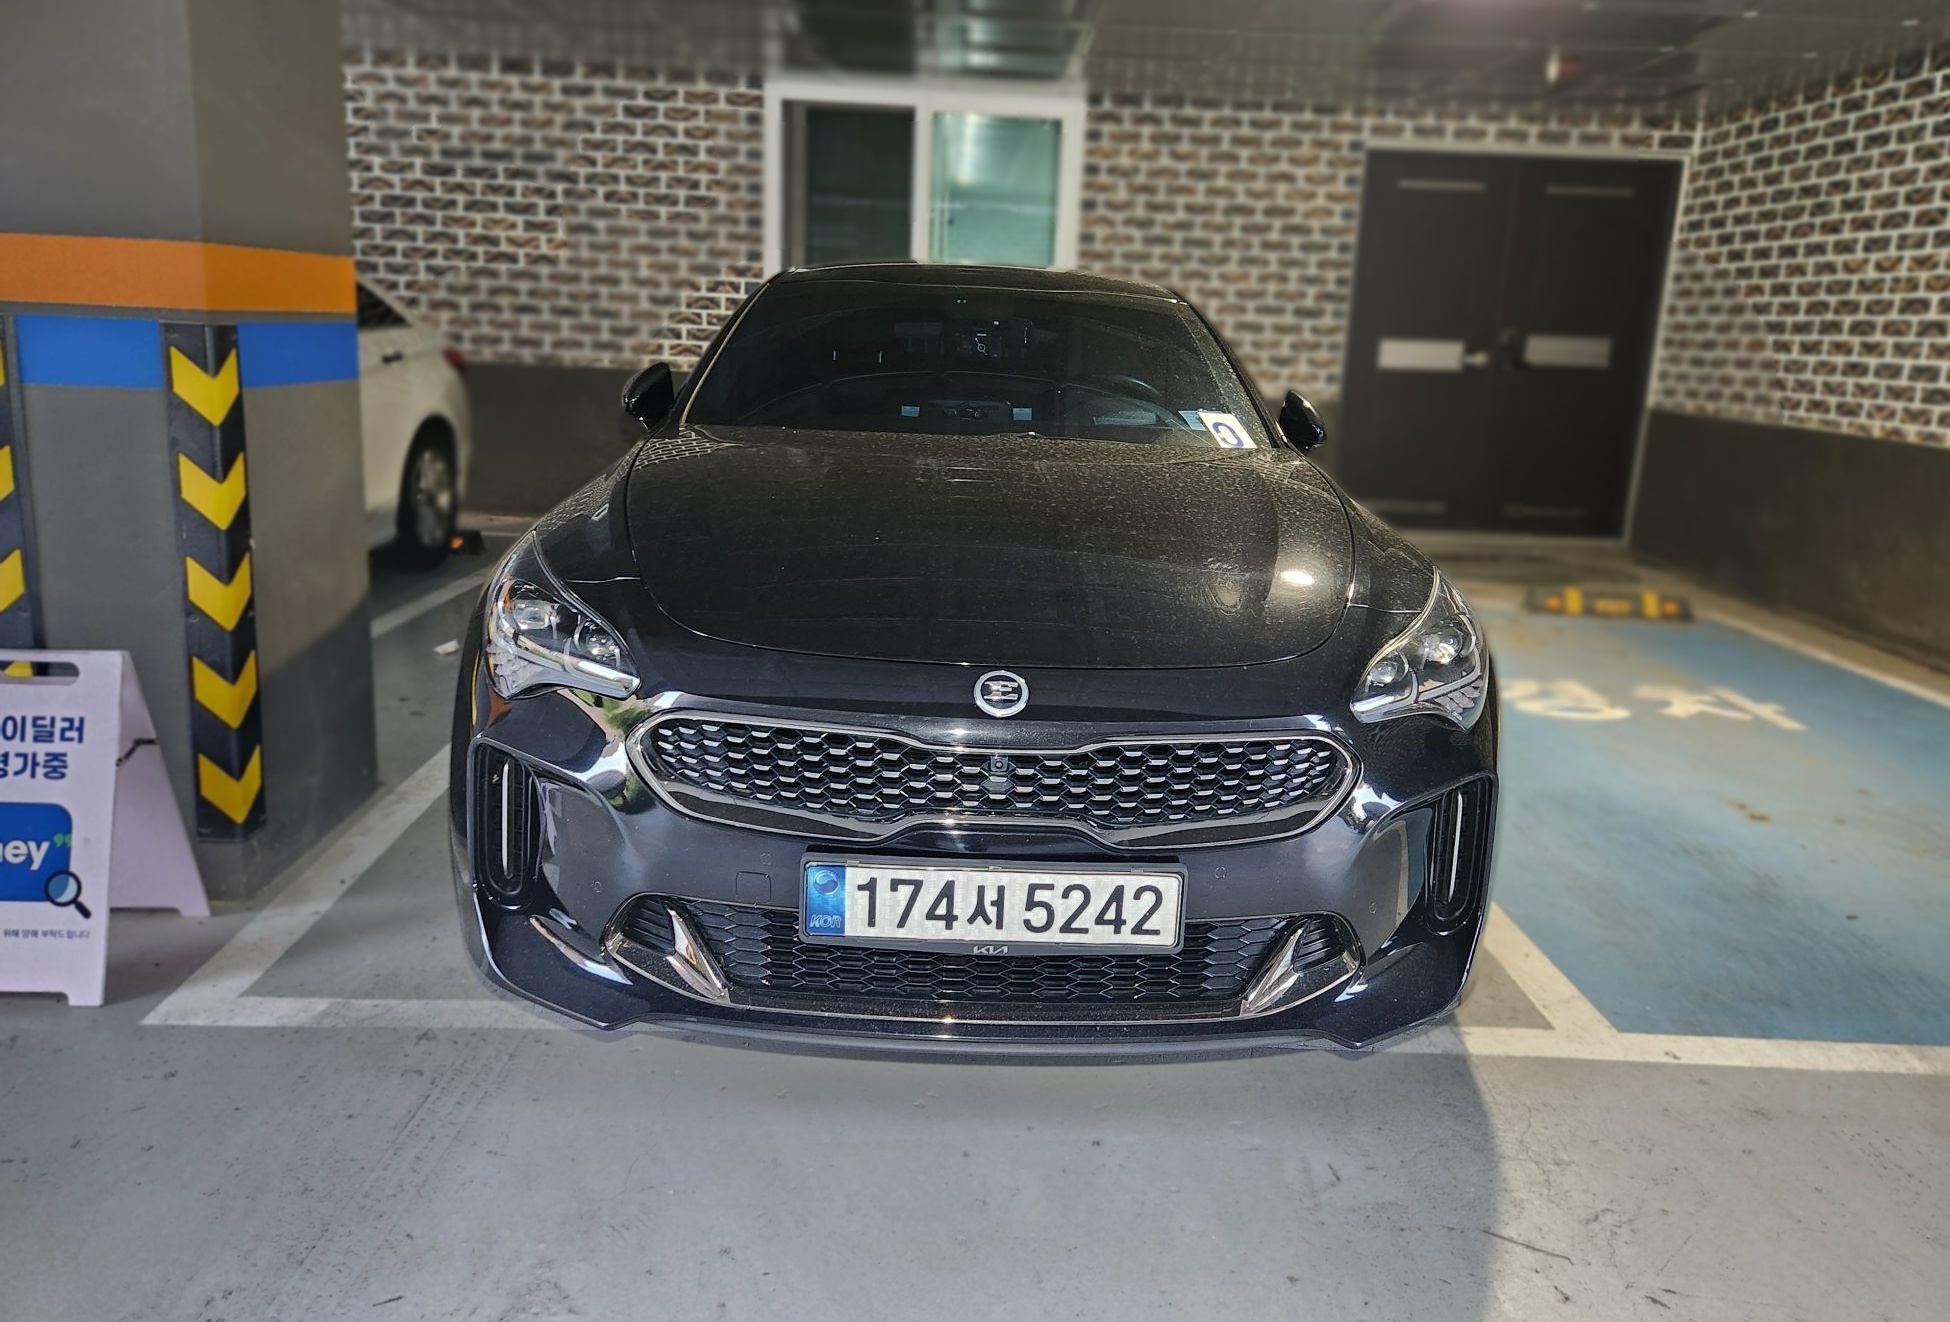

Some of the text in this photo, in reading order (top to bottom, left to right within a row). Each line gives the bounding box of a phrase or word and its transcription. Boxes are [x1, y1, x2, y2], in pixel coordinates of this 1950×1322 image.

[1, 715, 85, 744] 이딜러
[0, 840, 50, 870] ey
[856, 876, 1161, 936] 174서 5242
[810, 914, 842, 928] KOR
